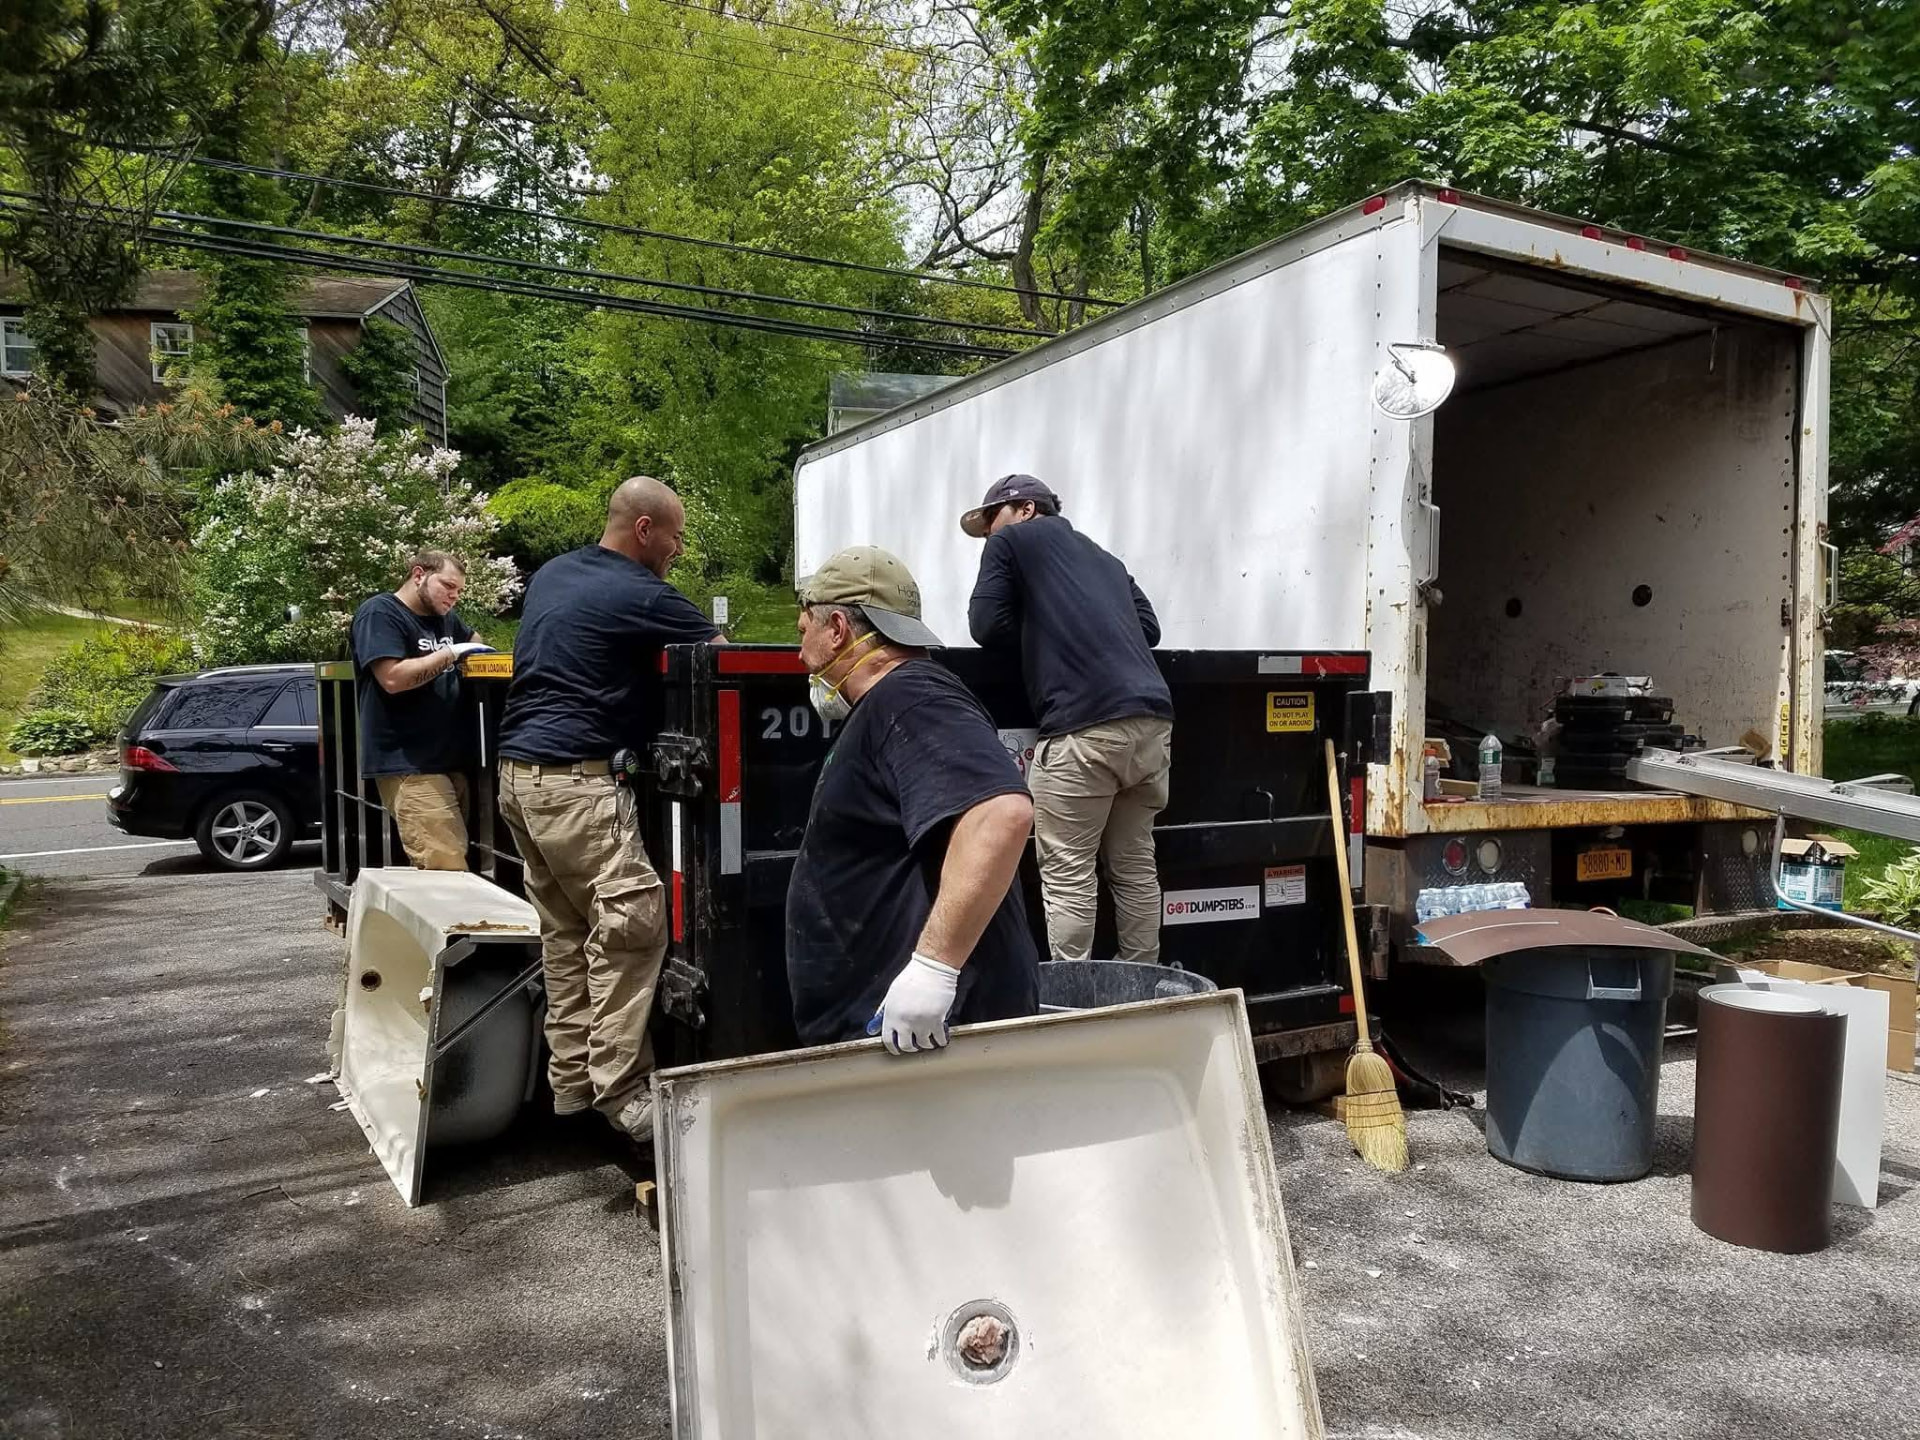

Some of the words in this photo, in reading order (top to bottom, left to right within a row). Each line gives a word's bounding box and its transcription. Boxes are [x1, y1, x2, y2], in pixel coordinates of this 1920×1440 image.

[1276, 697, 1306, 706] CAUTION
[1282, 711, 1293, 719] NOT
[1289, 719, 1312, 727] AROUND
